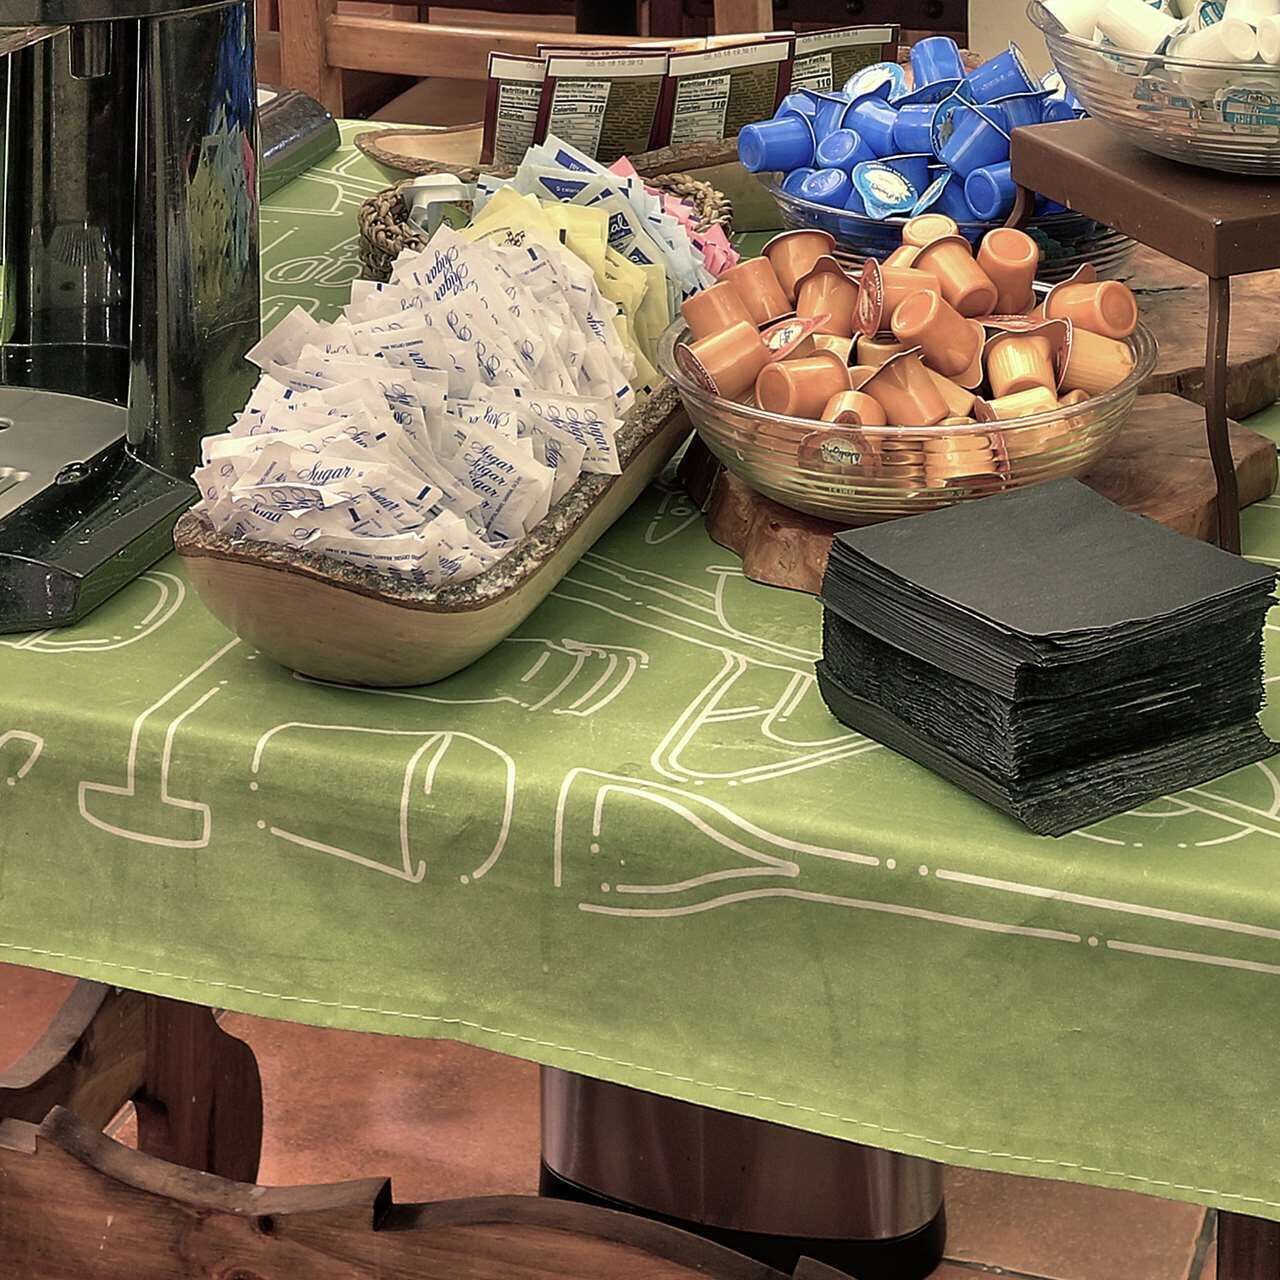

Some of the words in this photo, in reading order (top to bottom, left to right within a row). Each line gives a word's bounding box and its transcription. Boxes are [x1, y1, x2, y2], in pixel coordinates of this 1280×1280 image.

[816, 78, 831, 88] 110
[588, 104, 604, 113] 110
[711, 100, 726, 109] 110
[424, 245, 459, 284] Sugar
[433, 261, 469, 301] Sugar
[583, 408, 612, 452] Sugar
[297, 461, 357, 483] Sugar
[464, 452, 508, 486] Sugar
[471, 441, 517, 474] Sugar
